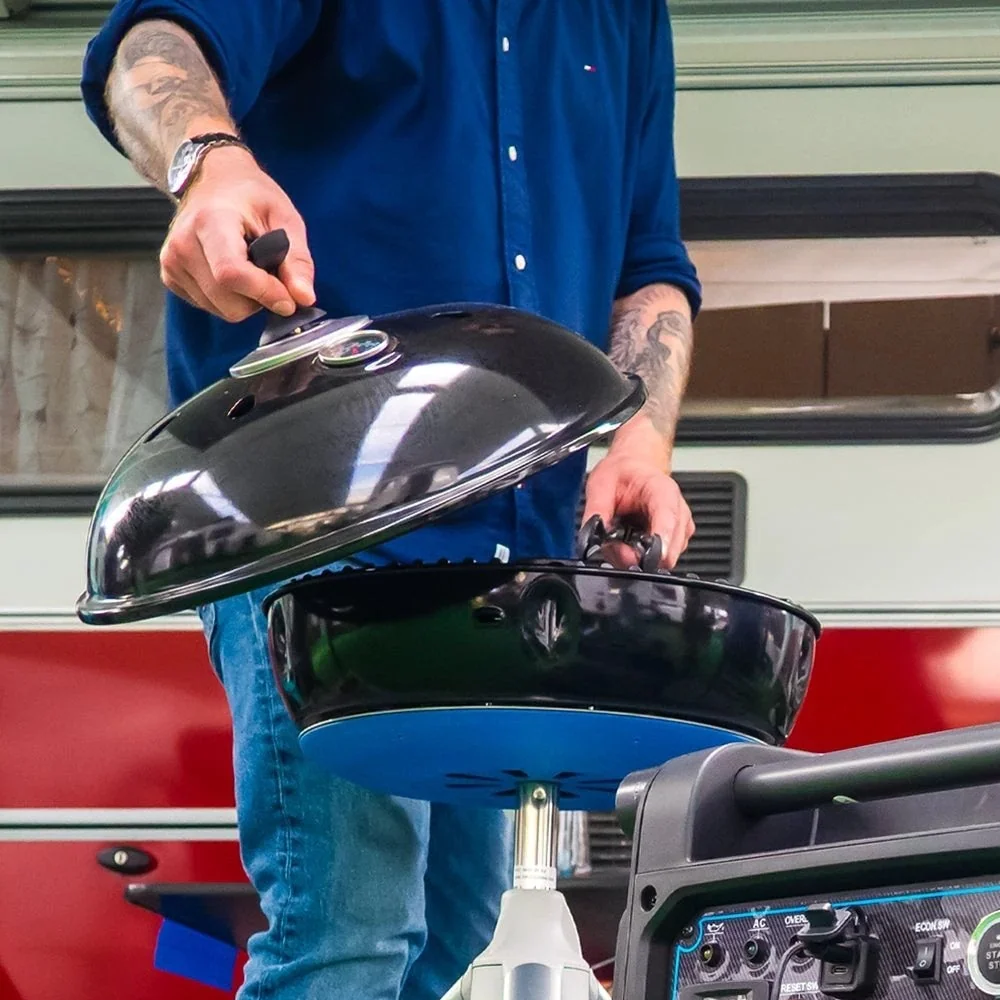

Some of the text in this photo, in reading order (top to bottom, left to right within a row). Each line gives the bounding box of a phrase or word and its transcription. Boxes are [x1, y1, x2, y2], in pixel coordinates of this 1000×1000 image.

[753, 919, 766, 928] AC
[785, 914, 808, 924] OVERL
[950, 941, 960, 950] ON
[947, 965, 960, 974] OFF
[781, 983, 806, 993] RESET
